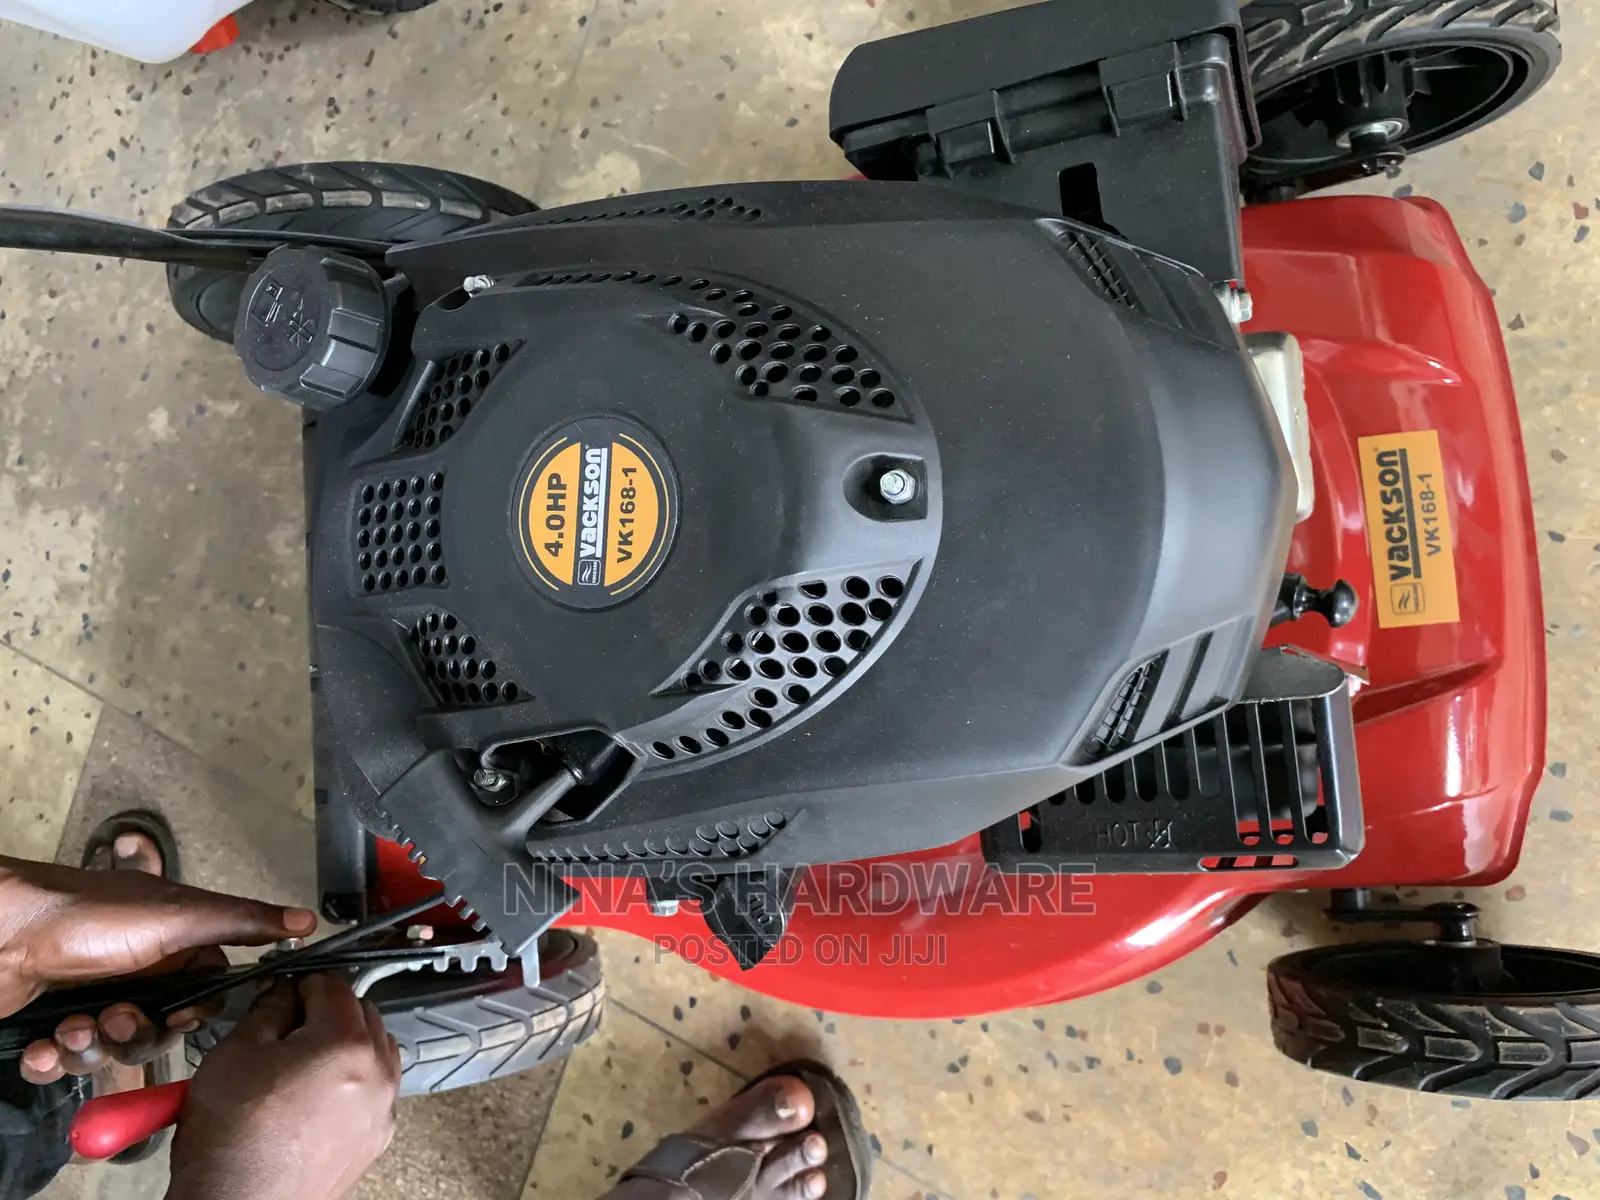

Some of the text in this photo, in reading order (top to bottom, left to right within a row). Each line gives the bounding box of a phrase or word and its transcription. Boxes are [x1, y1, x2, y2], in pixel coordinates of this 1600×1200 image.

[544, 472, 567, 557] 4.0HP
[616, 467, 637, 564] VK168-1
[1416, 471, 1442, 557] VK168-1
[1097, 822, 1139, 848] HOT
